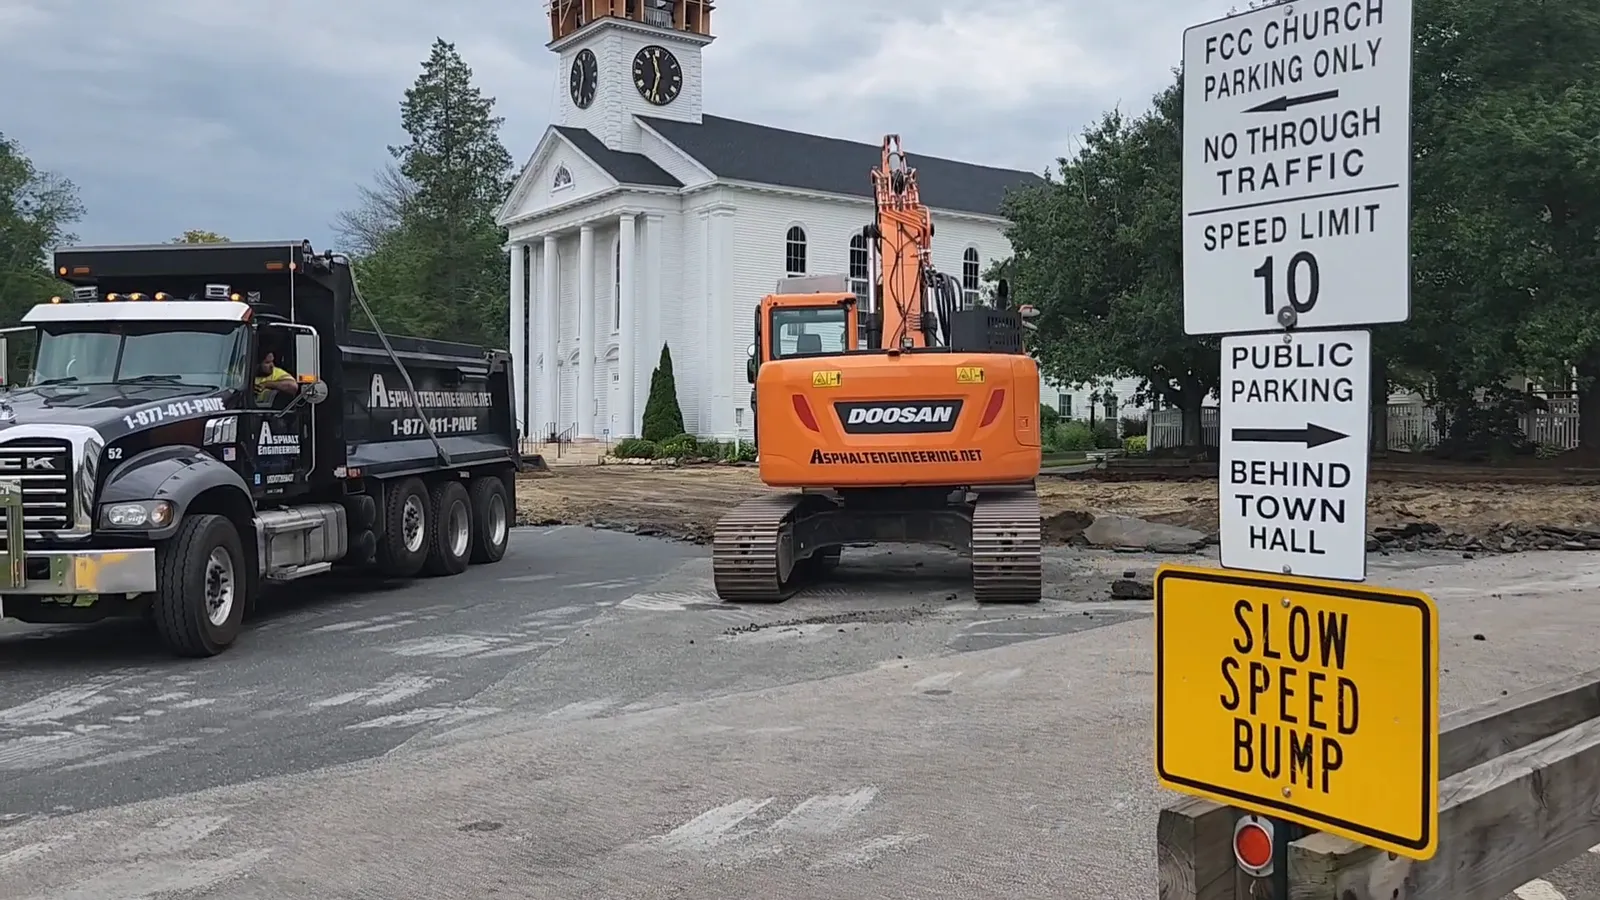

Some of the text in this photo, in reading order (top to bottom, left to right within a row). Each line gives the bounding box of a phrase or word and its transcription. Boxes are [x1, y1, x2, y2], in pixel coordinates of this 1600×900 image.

[1206, 0, 1382, 64] FCC CHURCH
[1205, 37, 1381, 102] PARKING ONLY
[1205, 106, 1380, 163] NO THROUGH
[1217, 149, 1363, 195] TRAFFIC
[1204, 204, 1379, 251] SPEED LIMIT
[1254, 251, 1319, 315] 10
[1233, 343, 1353, 369] PUBLIC
[1232, 378, 1352, 402] PARKING
[123, 397, 226, 429] 1-877-411-PAVE
[391, 416, 477, 435] 1-877411-PAVE
[847, 406, 952, 424] DOOSAN
[259, 421, 299, 445] ASPHALT
[108, 447, 122, 459] 52
[810, 449, 983, 464] ASPHALTENGINEERING.NET
[1231, 460, 1350, 488] BEHIND
[1235, 494, 1344, 523] TOWN
[1250, 526, 1325, 554] HALL
[1234, 600, 1348, 670] SLOW
[1220, 657, 1358, 735] SPEED
[1234, 717, 1343, 793] BUMP
